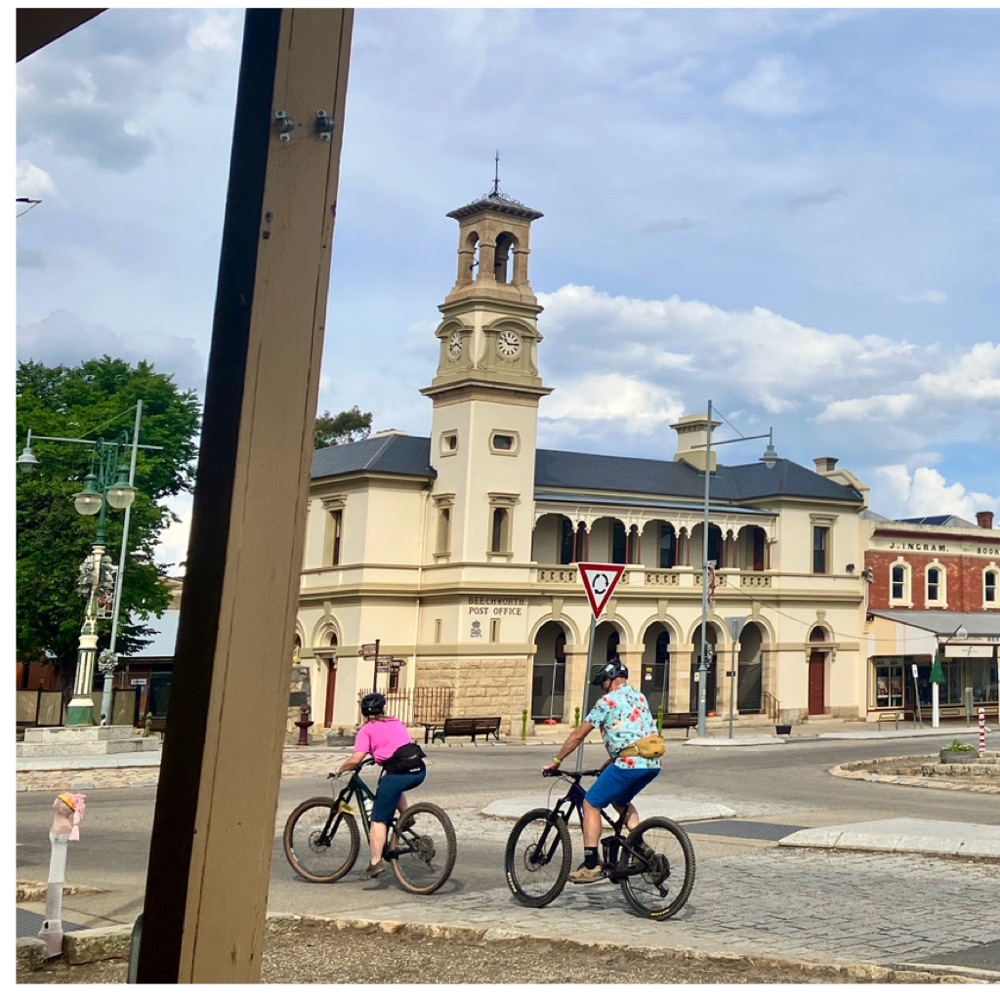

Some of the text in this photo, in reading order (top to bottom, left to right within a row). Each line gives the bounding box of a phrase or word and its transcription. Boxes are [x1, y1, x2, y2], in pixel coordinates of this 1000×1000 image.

[468, 596, 525, 606] BEECHWORTH
[468, 607, 522, 615] POST OFFICE
